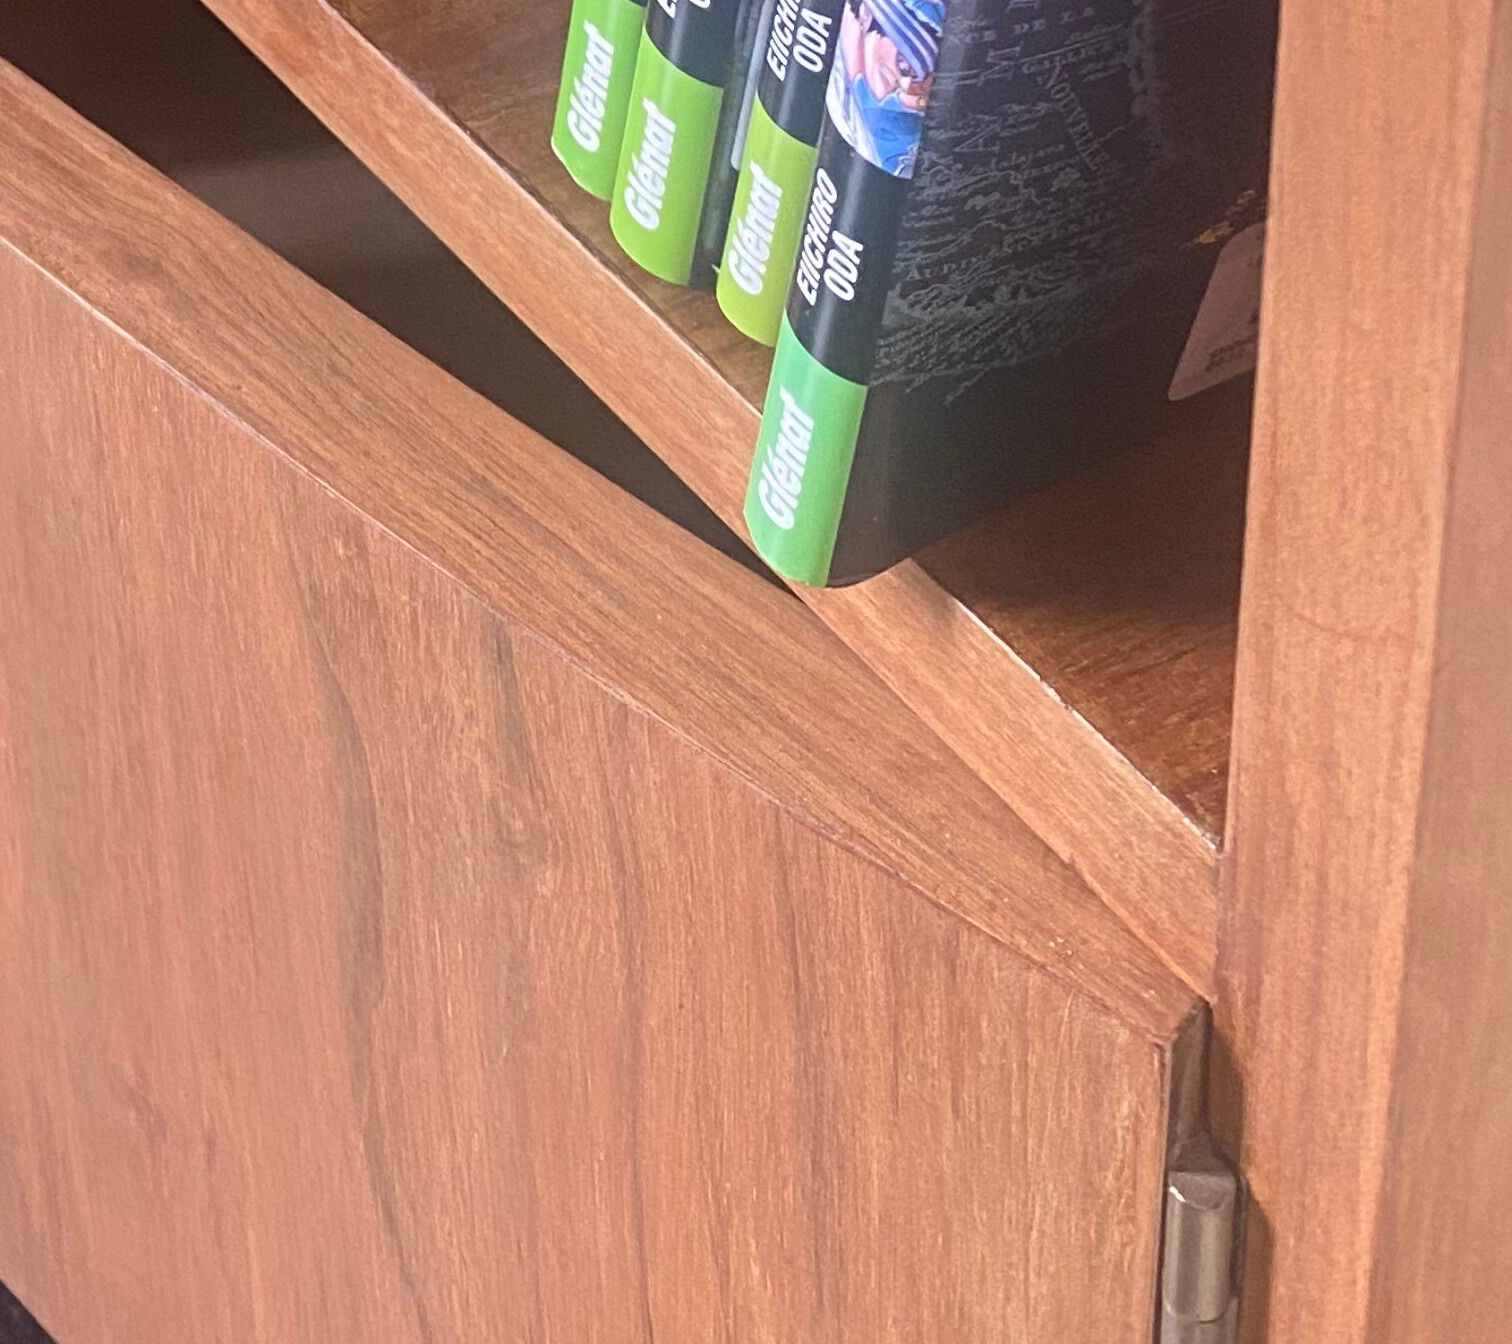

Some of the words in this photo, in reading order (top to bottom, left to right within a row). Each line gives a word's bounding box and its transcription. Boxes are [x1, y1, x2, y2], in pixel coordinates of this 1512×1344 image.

[567, 19, 615, 153] Glénat
[793, 7, 832, 73] ODA
[624, 97, 676, 230] Glénat
[728, 159, 783, 295] Glénat
[796, 167, 839, 306] EIICHIRO
[823, 229, 864, 302] ODA
[758, 384, 815, 530] Glénat
